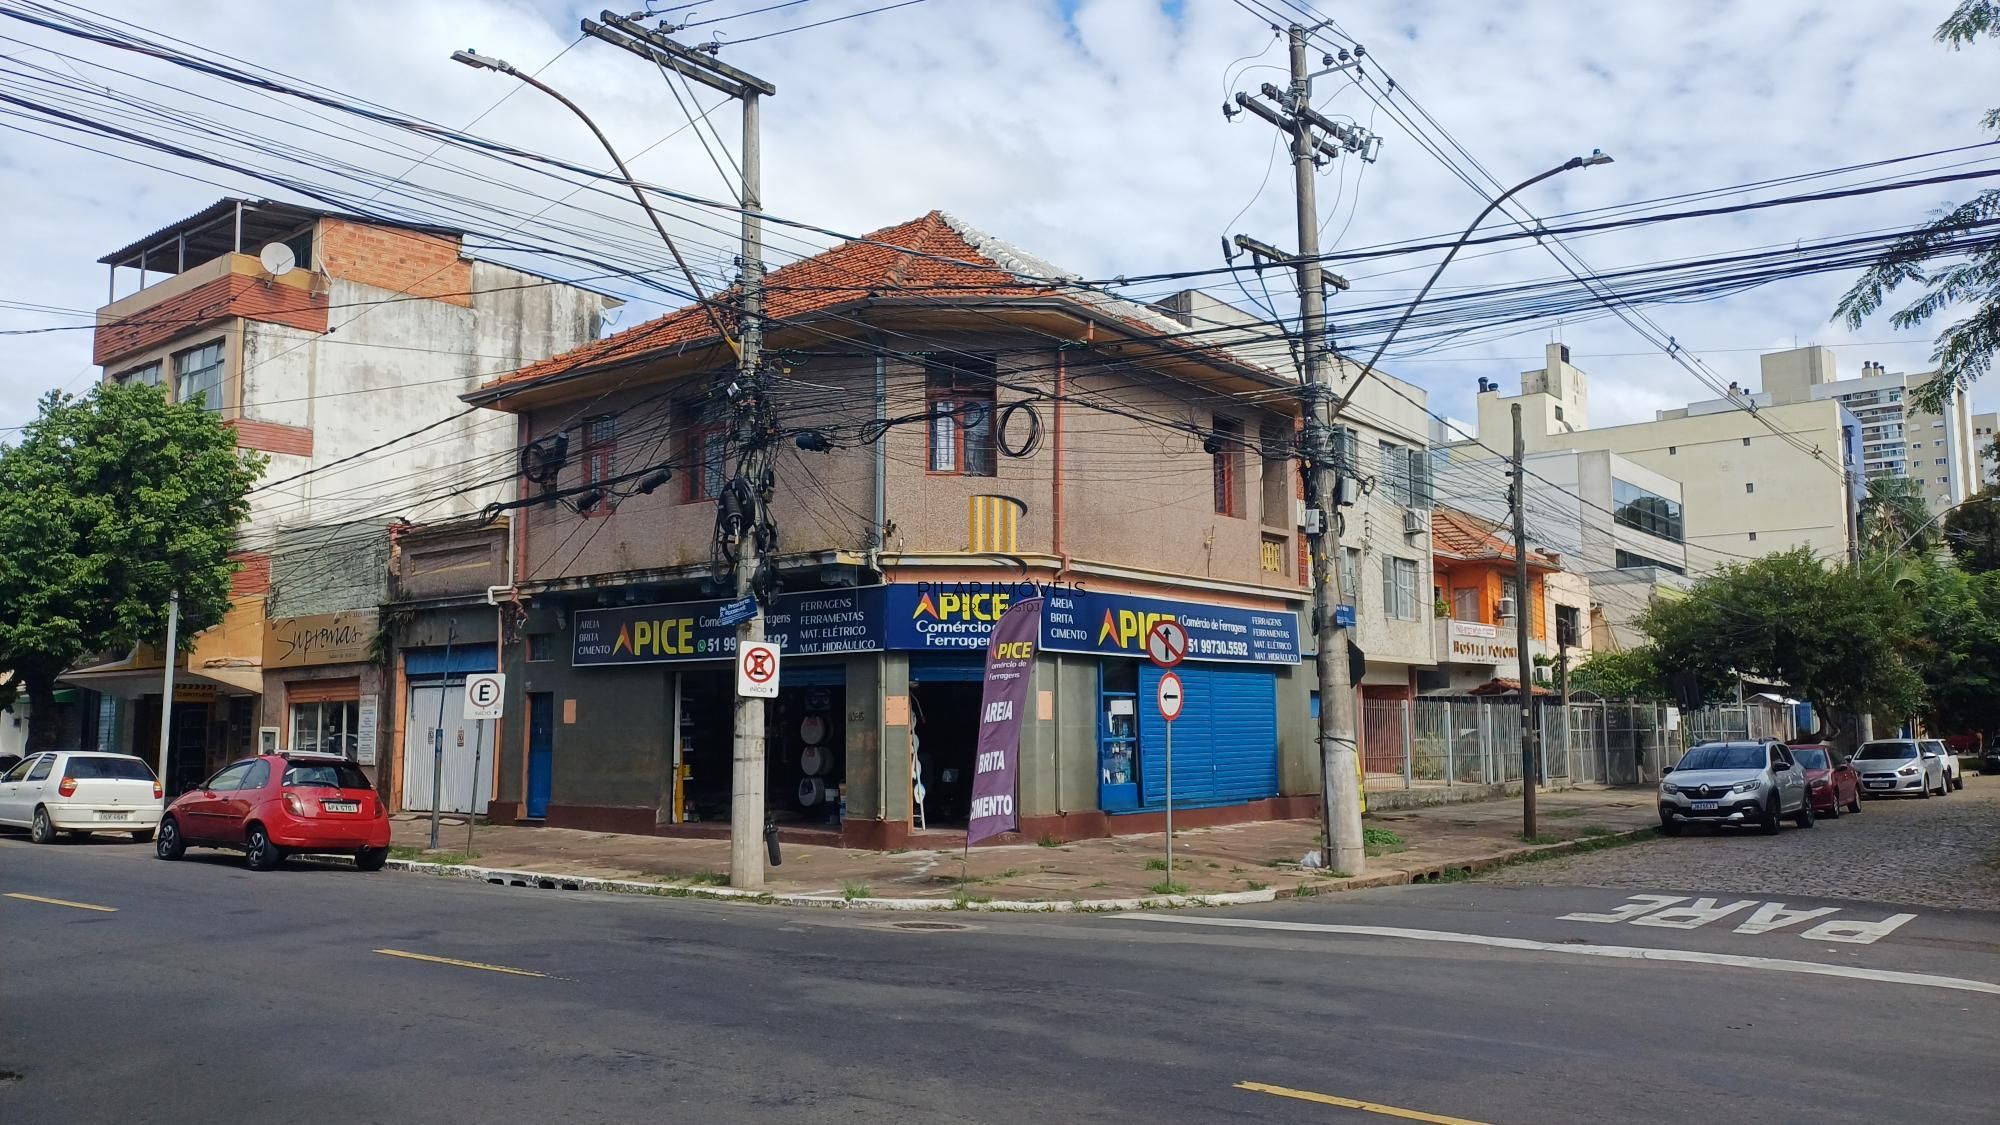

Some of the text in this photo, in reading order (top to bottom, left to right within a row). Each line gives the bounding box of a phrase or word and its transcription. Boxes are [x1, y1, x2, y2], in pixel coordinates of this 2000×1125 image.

[800, 598, 852, 612] FERRAGENS
[1050, 598, 1074, 609] AREIA
[580, 619, 600, 630] AREIA
[800, 611, 865, 625] FERRAMENTAS
[1050, 612, 1074, 625] BRITA
[1182, 614, 1247, 635] Comércio de Ferragens
[1251, 616, 1282, 627] FERRAGENS
[800, 625, 866, 639] MAT. ELÉTRICO
[916, 619, 991, 633] Comércio
[579, 632, 599, 642] BRITA
[1050, 628, 1088, 641] CIMENTO
[1252, 628, 1290, 639] FERRAMENTAS
[578, 645, 611, 655] CIMENTO
[707, 638, 720, 652] 51
[800, 638, 876, 653] MAT. HIDRÁULICO
[1188, 638, 1248, 656] 51 99730.5592
[479, 684, 490, 702] E
[984, 700, 1013, 724] AREIA
[978, 750, 1005, 775] BRITA
[1555, 894, 1918, 945] PARE
